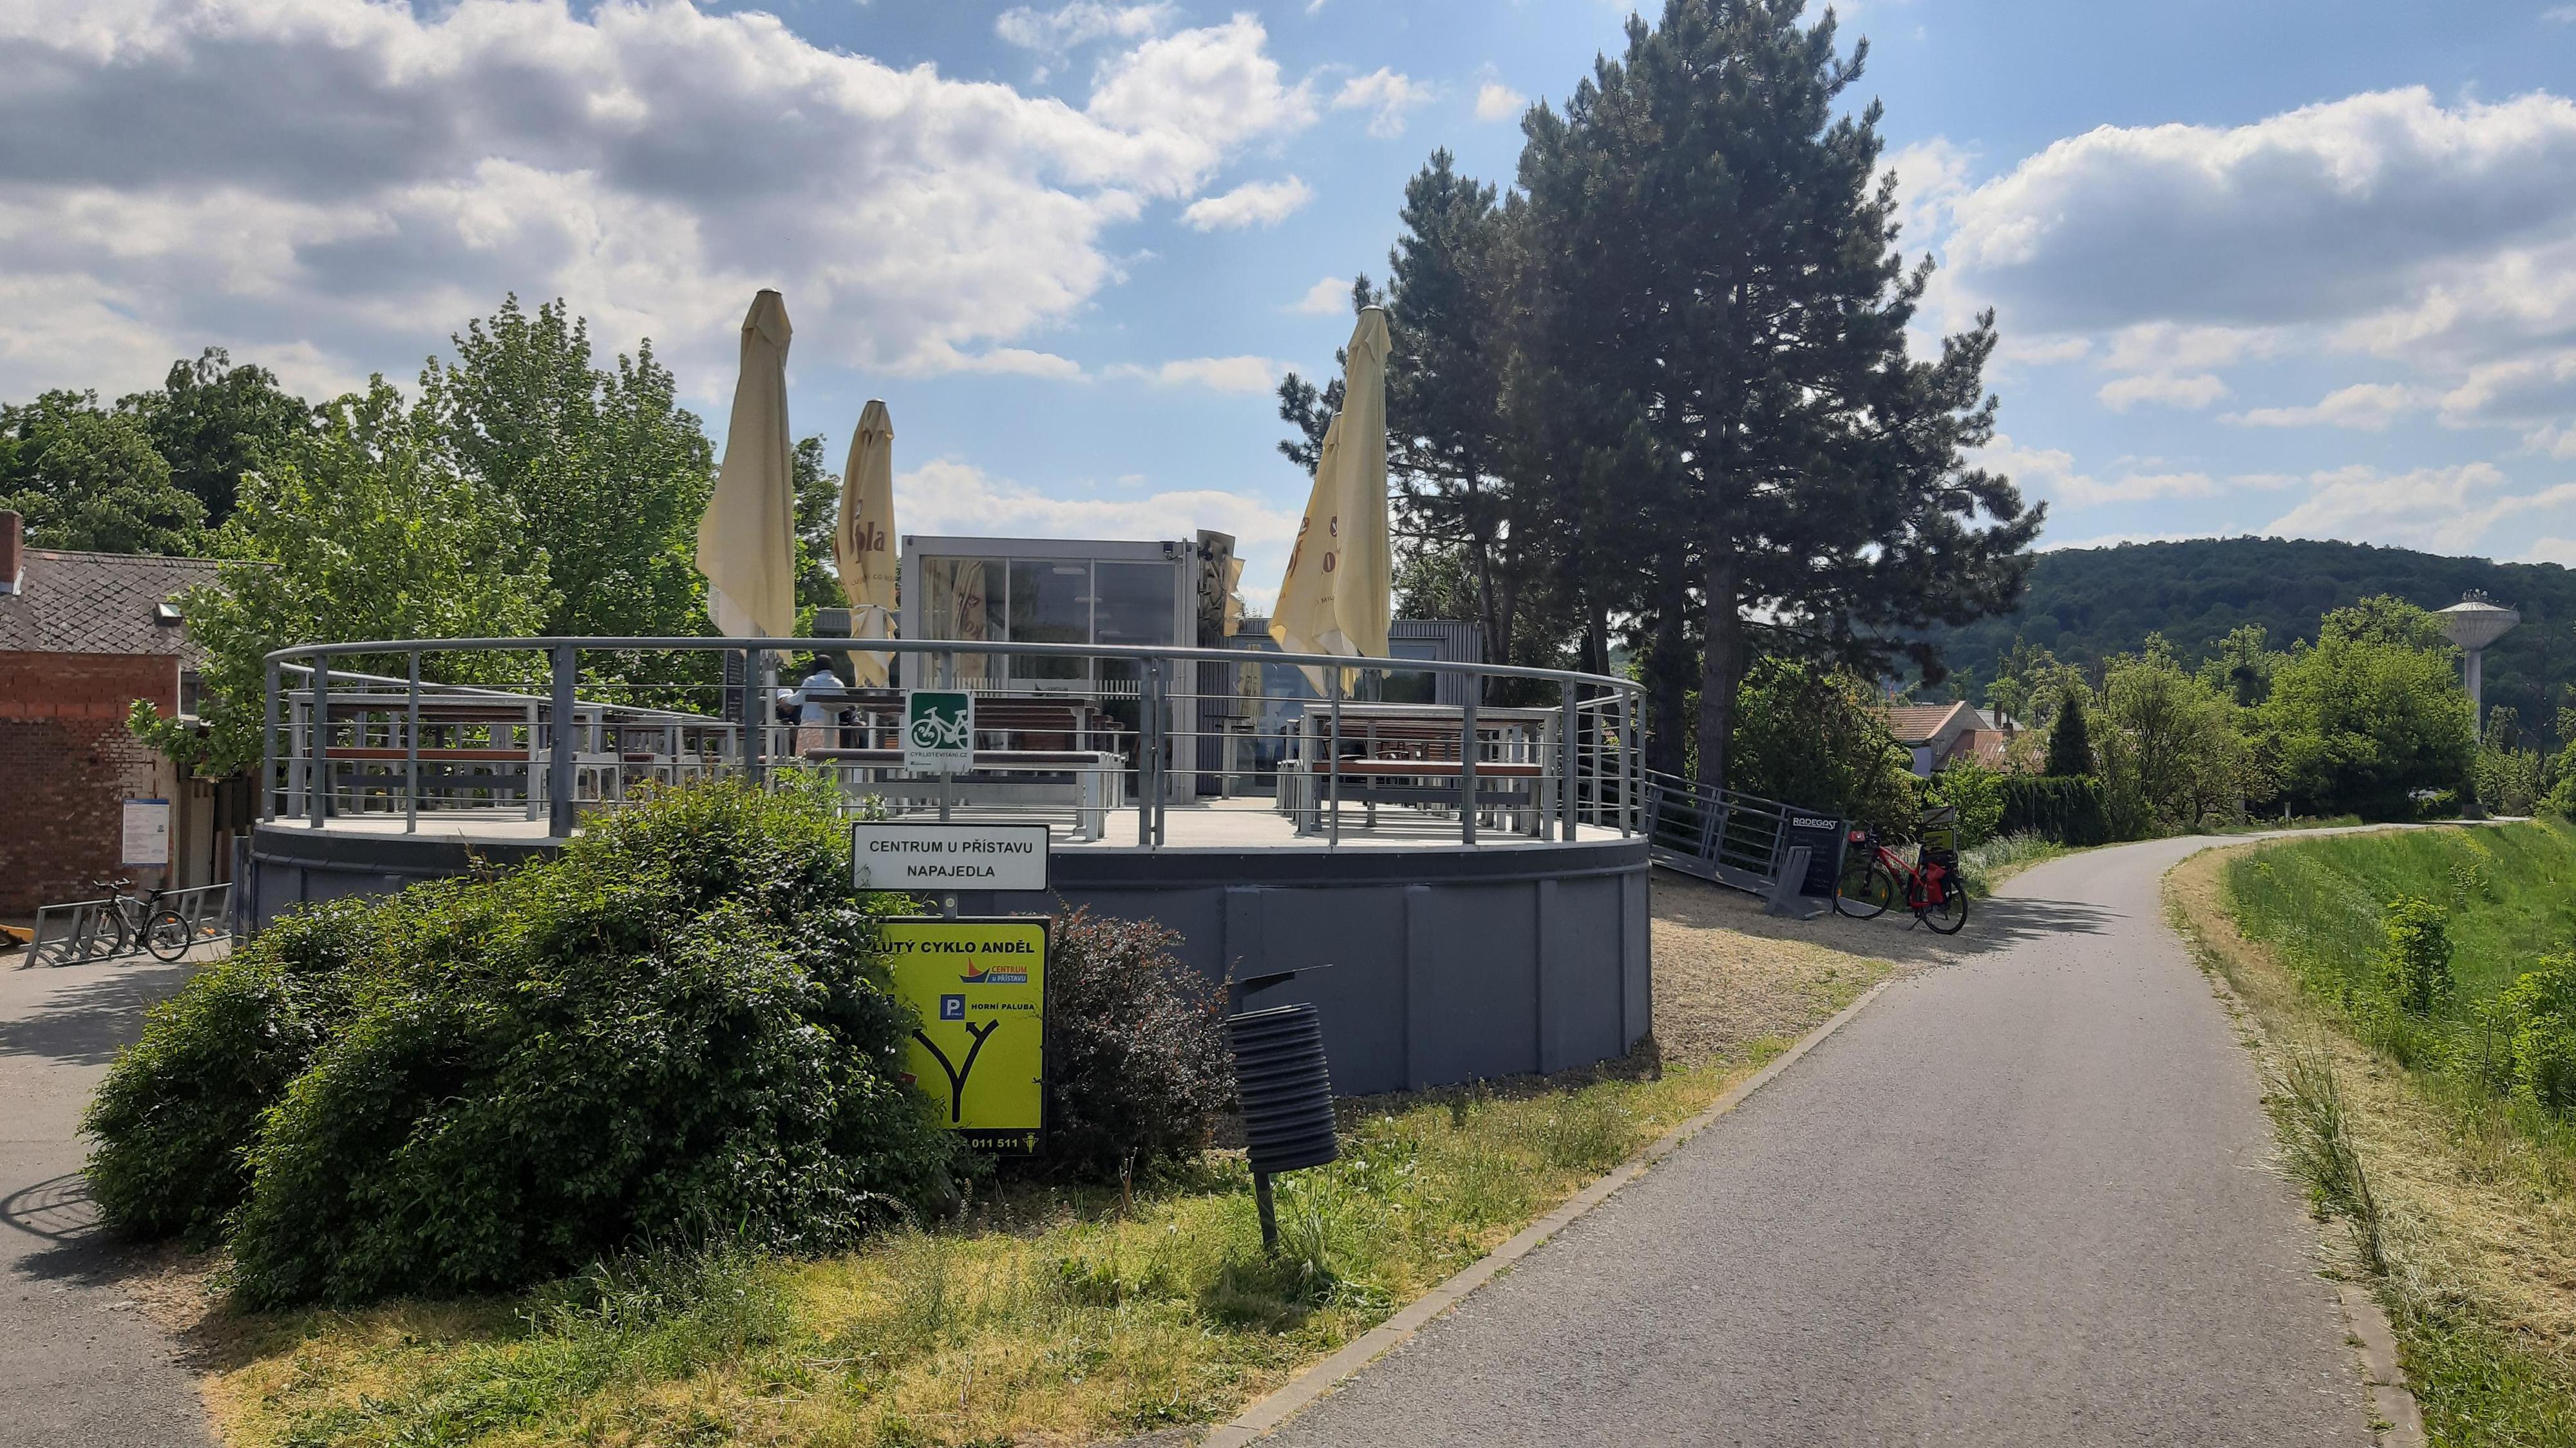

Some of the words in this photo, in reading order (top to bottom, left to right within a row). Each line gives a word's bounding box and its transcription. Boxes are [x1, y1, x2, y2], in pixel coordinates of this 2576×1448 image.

[1793, 816, 1838, 830] RADEGAST
[869, 840, 943, 853] CENTRUM
[948, 841, 957, 853] U
[962, 838, 1033, 854] PŘÍSTAVU
[907, 865, 996, 878] NAPAJEDLA
[869, 939, 916, 953] LUTÝ
[920, 941, 976, 954] CYKLO
[981, 939, 1035, 954] ANDĚL
[947, 999, 960, 1015] P
[972, 1138, 992, 1148] 011
[997, 1138, 1018, 1147] 511
